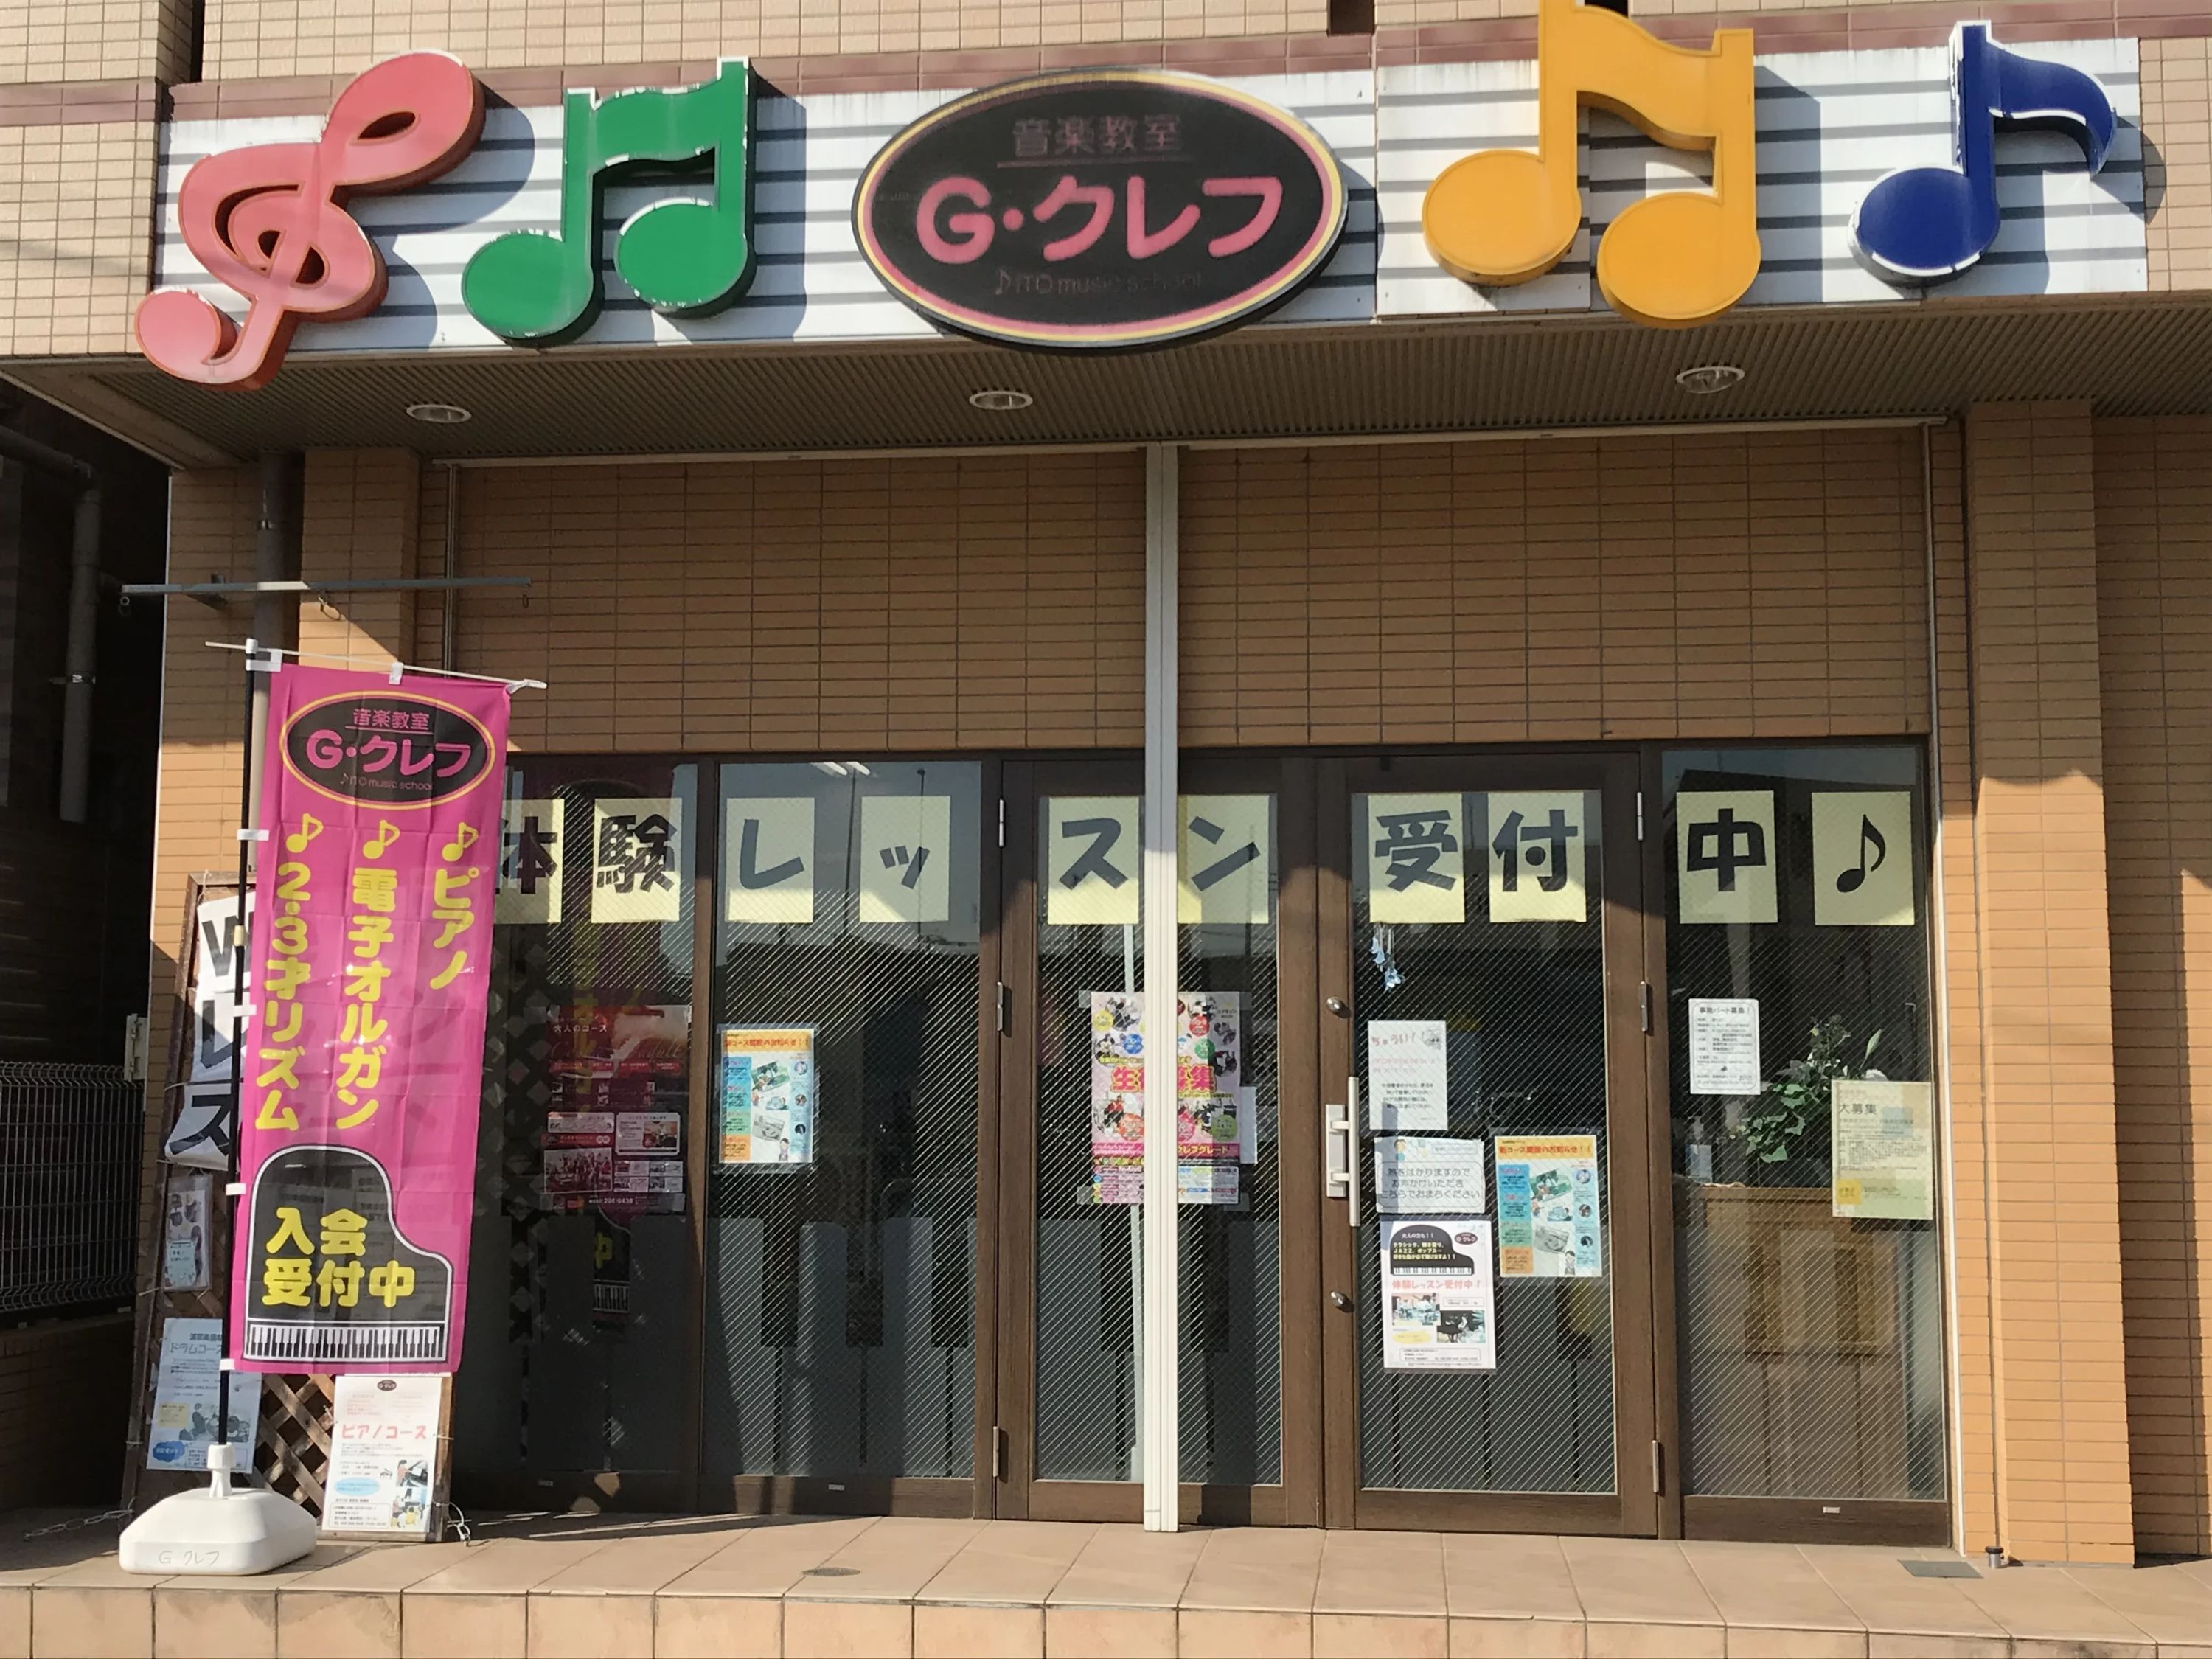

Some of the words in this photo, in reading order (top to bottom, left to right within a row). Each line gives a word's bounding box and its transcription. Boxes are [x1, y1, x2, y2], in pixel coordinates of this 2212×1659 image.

[1013, 114, 1180, 157] 音楽教室
[916, 174, 1283, 264] G・クレフ
[352, 708, 430, 730] 音楽教室
[306, 729, 471, 778] G・クレフ
[368, 779, 397, 789] music
[400, 780, 433, 791] school
[430, 867, 479, 990] ピアノ
[336, 868, 397, 1130] 電子オルガン
[1838, 1103, 1877, 1115] 大募集
[266, 1207, 368, 1256] 入会
[262, 1258, 415, 1307] 受付中
[341, 1425, 427, 1440] ピアノコース
[159, 1550, 173, 1564] G
[183, 1549, 220, 1566] クレフ
